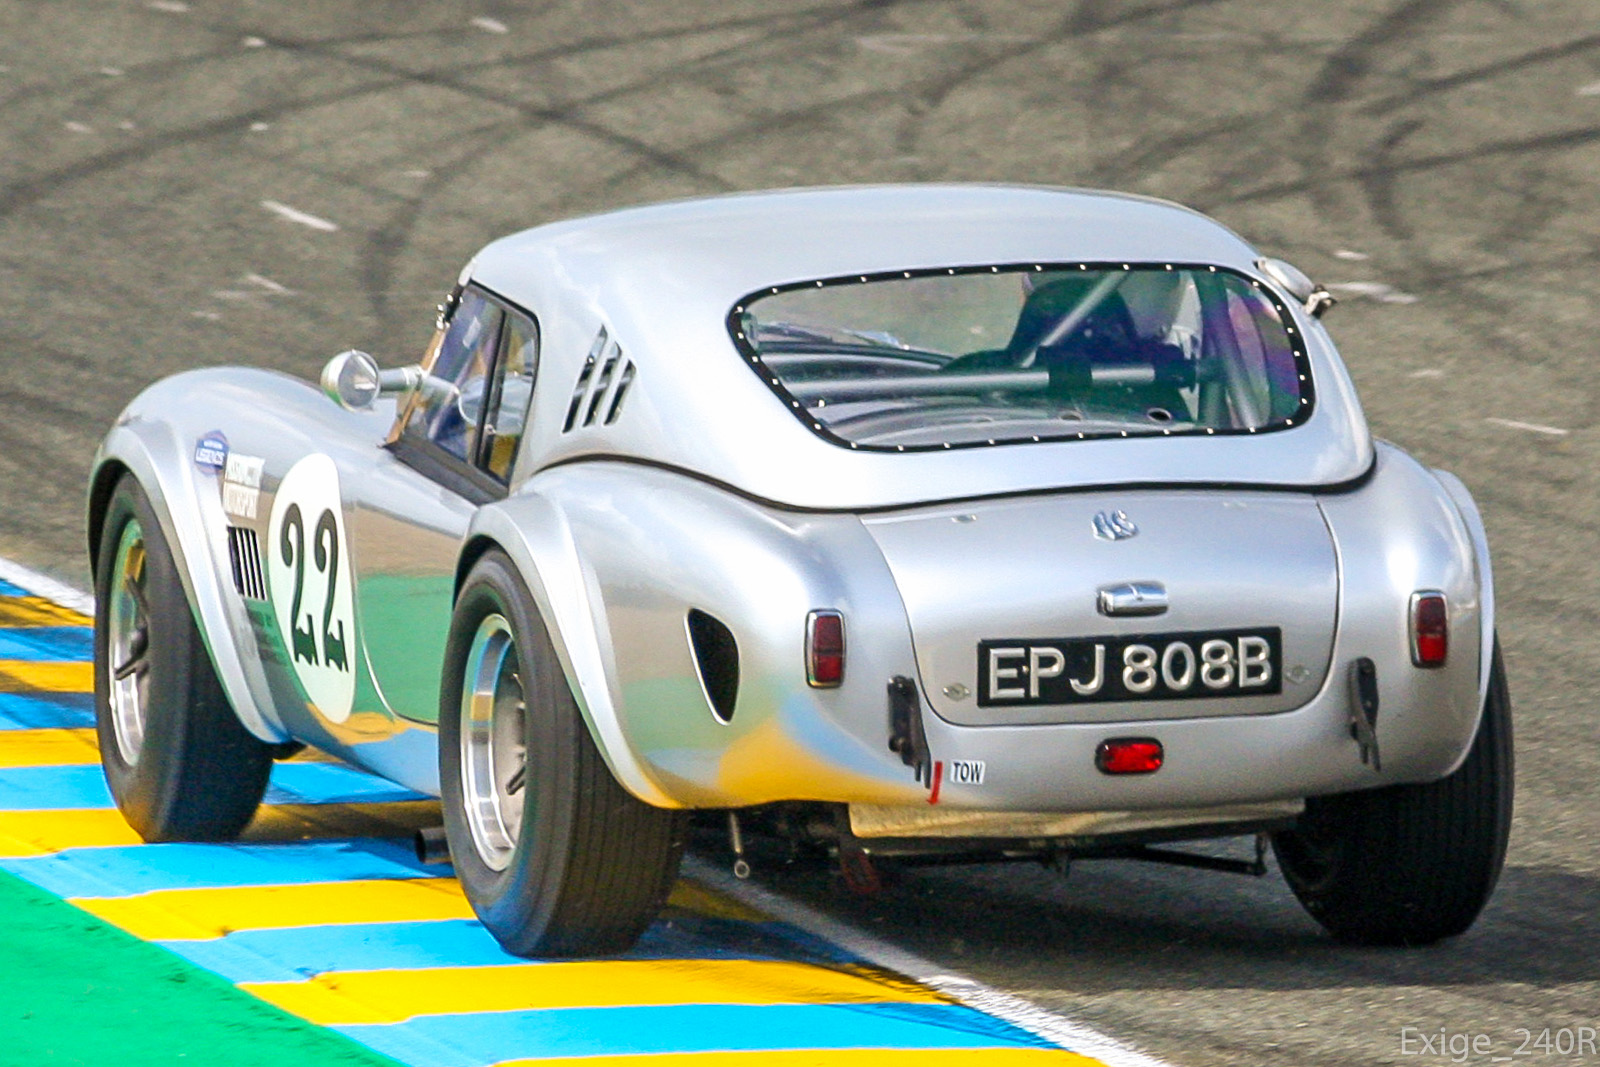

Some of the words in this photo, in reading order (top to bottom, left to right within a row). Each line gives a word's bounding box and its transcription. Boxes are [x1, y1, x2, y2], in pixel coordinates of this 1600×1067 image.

[280, 502, 349, 673] 22
[989, 643, 1106, 699] EPJ
[1122, 636, 1272, 693] 808B
[953, 761, 983, 783] TOW
